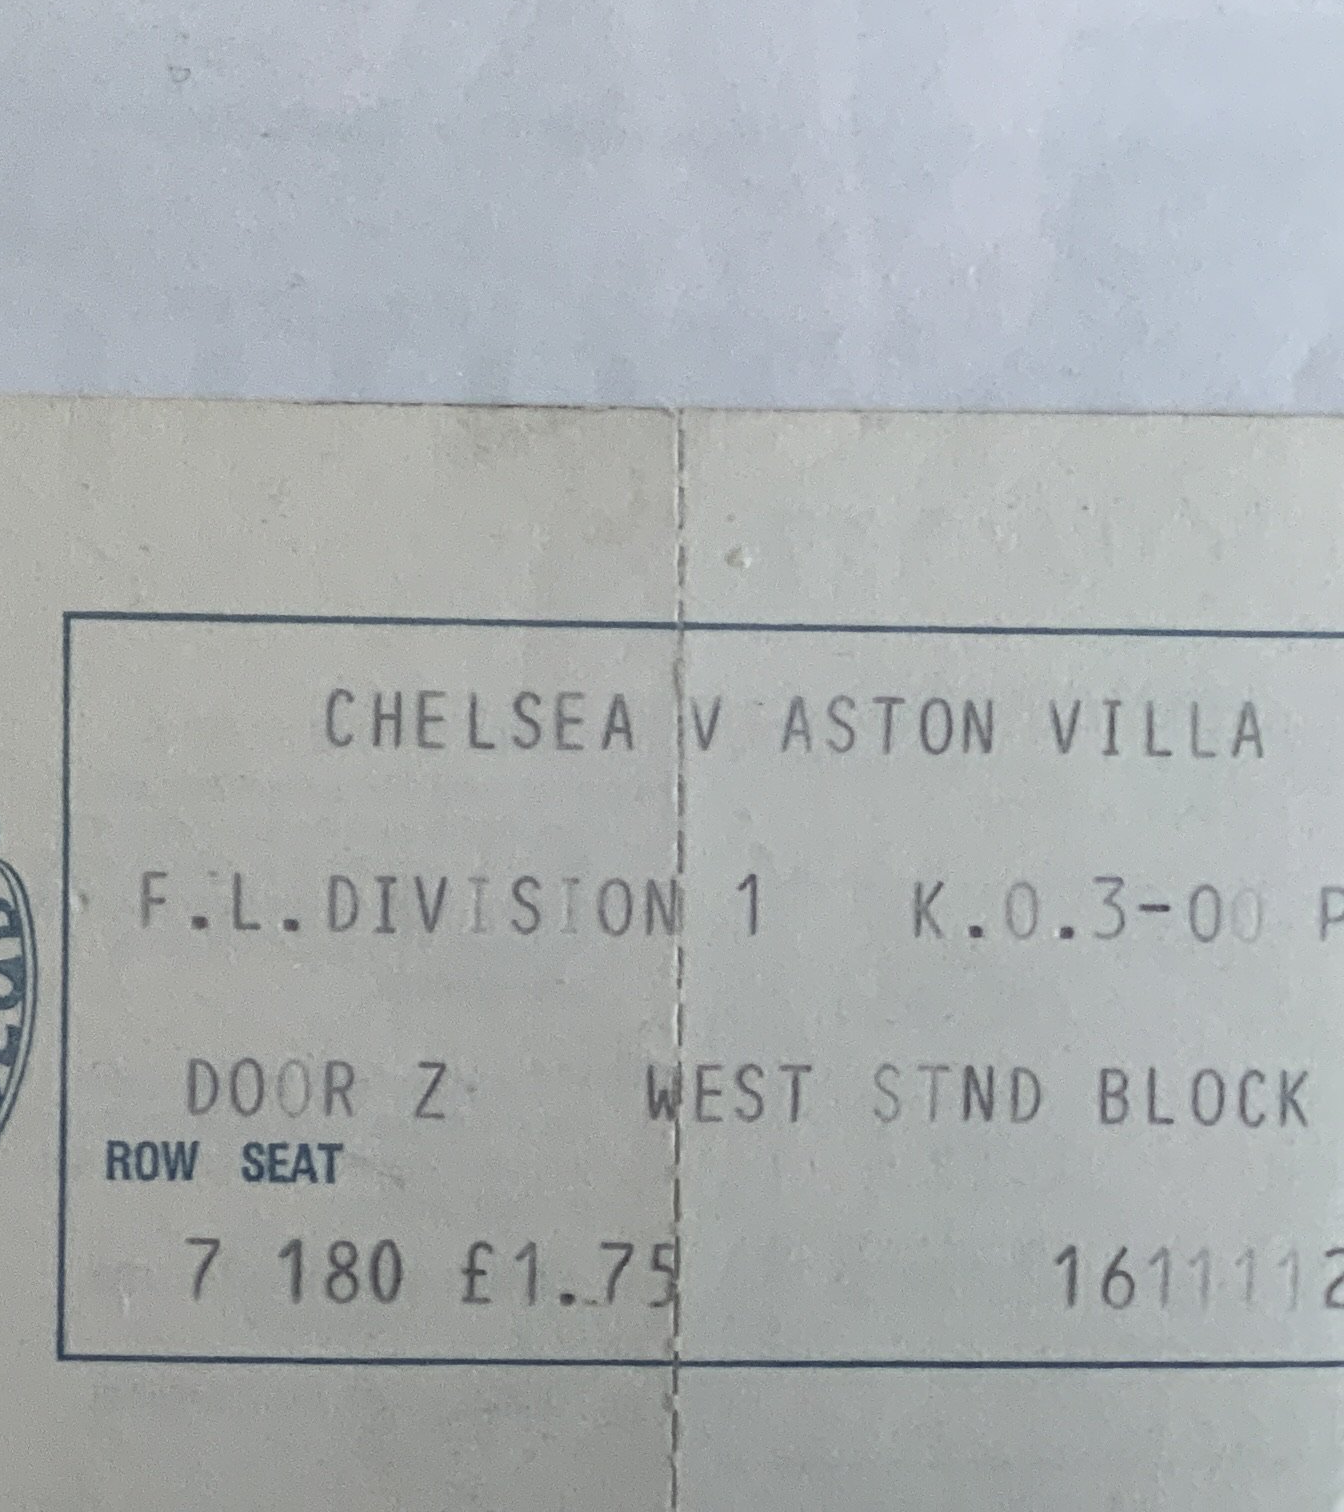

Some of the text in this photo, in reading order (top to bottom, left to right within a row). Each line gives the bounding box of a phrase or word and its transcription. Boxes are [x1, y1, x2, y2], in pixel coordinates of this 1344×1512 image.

[324, 688, 1265, 758] CHELSEA ASTON VILLA
[187, 1058, 1309, 1128] DOOR WEST STND BLOCK
[106, 1140, 343, 1183] ROW SEAT
[278, 1239, 676, 1308] 180 £1.75
